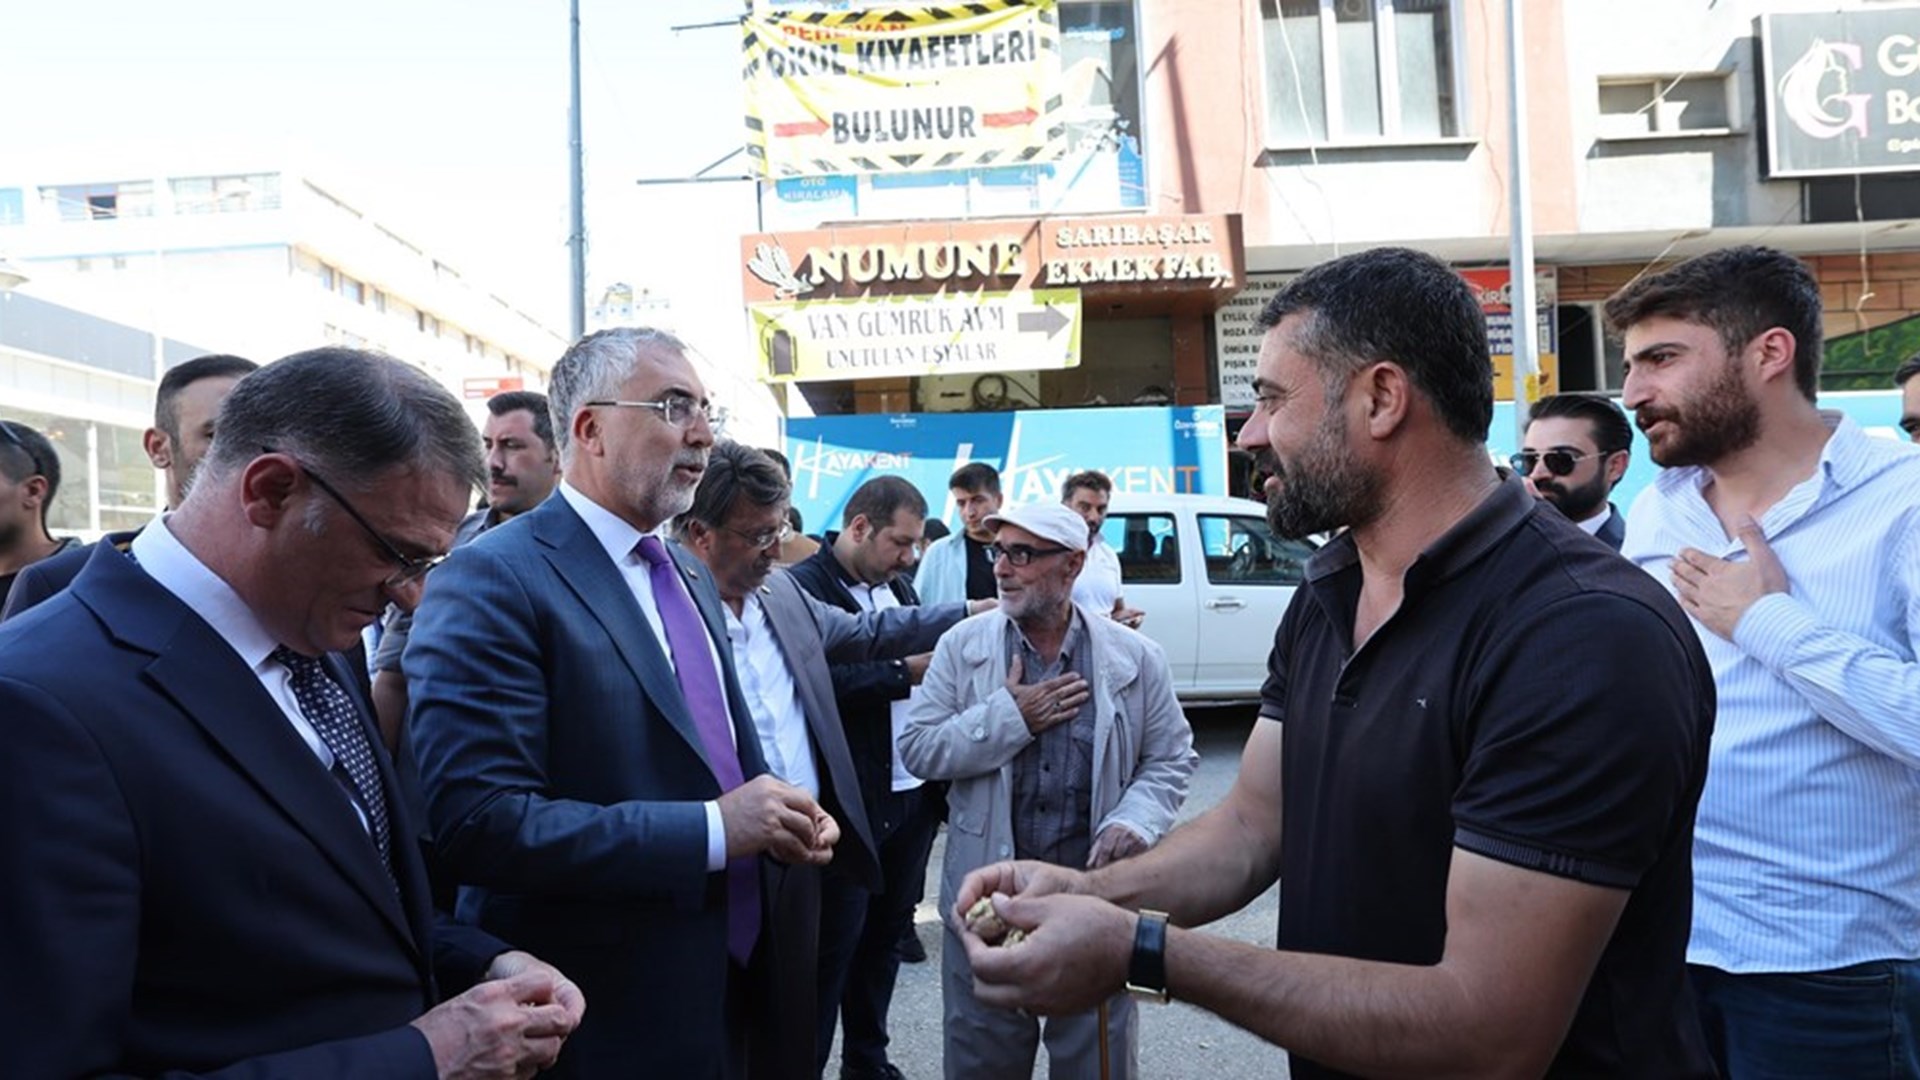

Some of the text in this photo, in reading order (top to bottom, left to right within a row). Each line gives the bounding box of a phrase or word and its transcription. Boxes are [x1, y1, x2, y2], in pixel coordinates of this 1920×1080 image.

[856, 18, 1037, 75] KIYAFETLERİ
[1877, 34, 1920, 77] G
[832, 106, 976, 144] BULUNUR
[800, 177, 827, 188] OTO
[1057, 222, 1213, 249] SARIBAŞAK
[808, 237, 1026, 286] NUMUNE
[1046, 256, 1159, 284] EKMEK
[807, 299, 1005, 339] VAN GÜMRÜK AVM
[826, 342, 997, 369] UNUTULAN EŞYALAR
